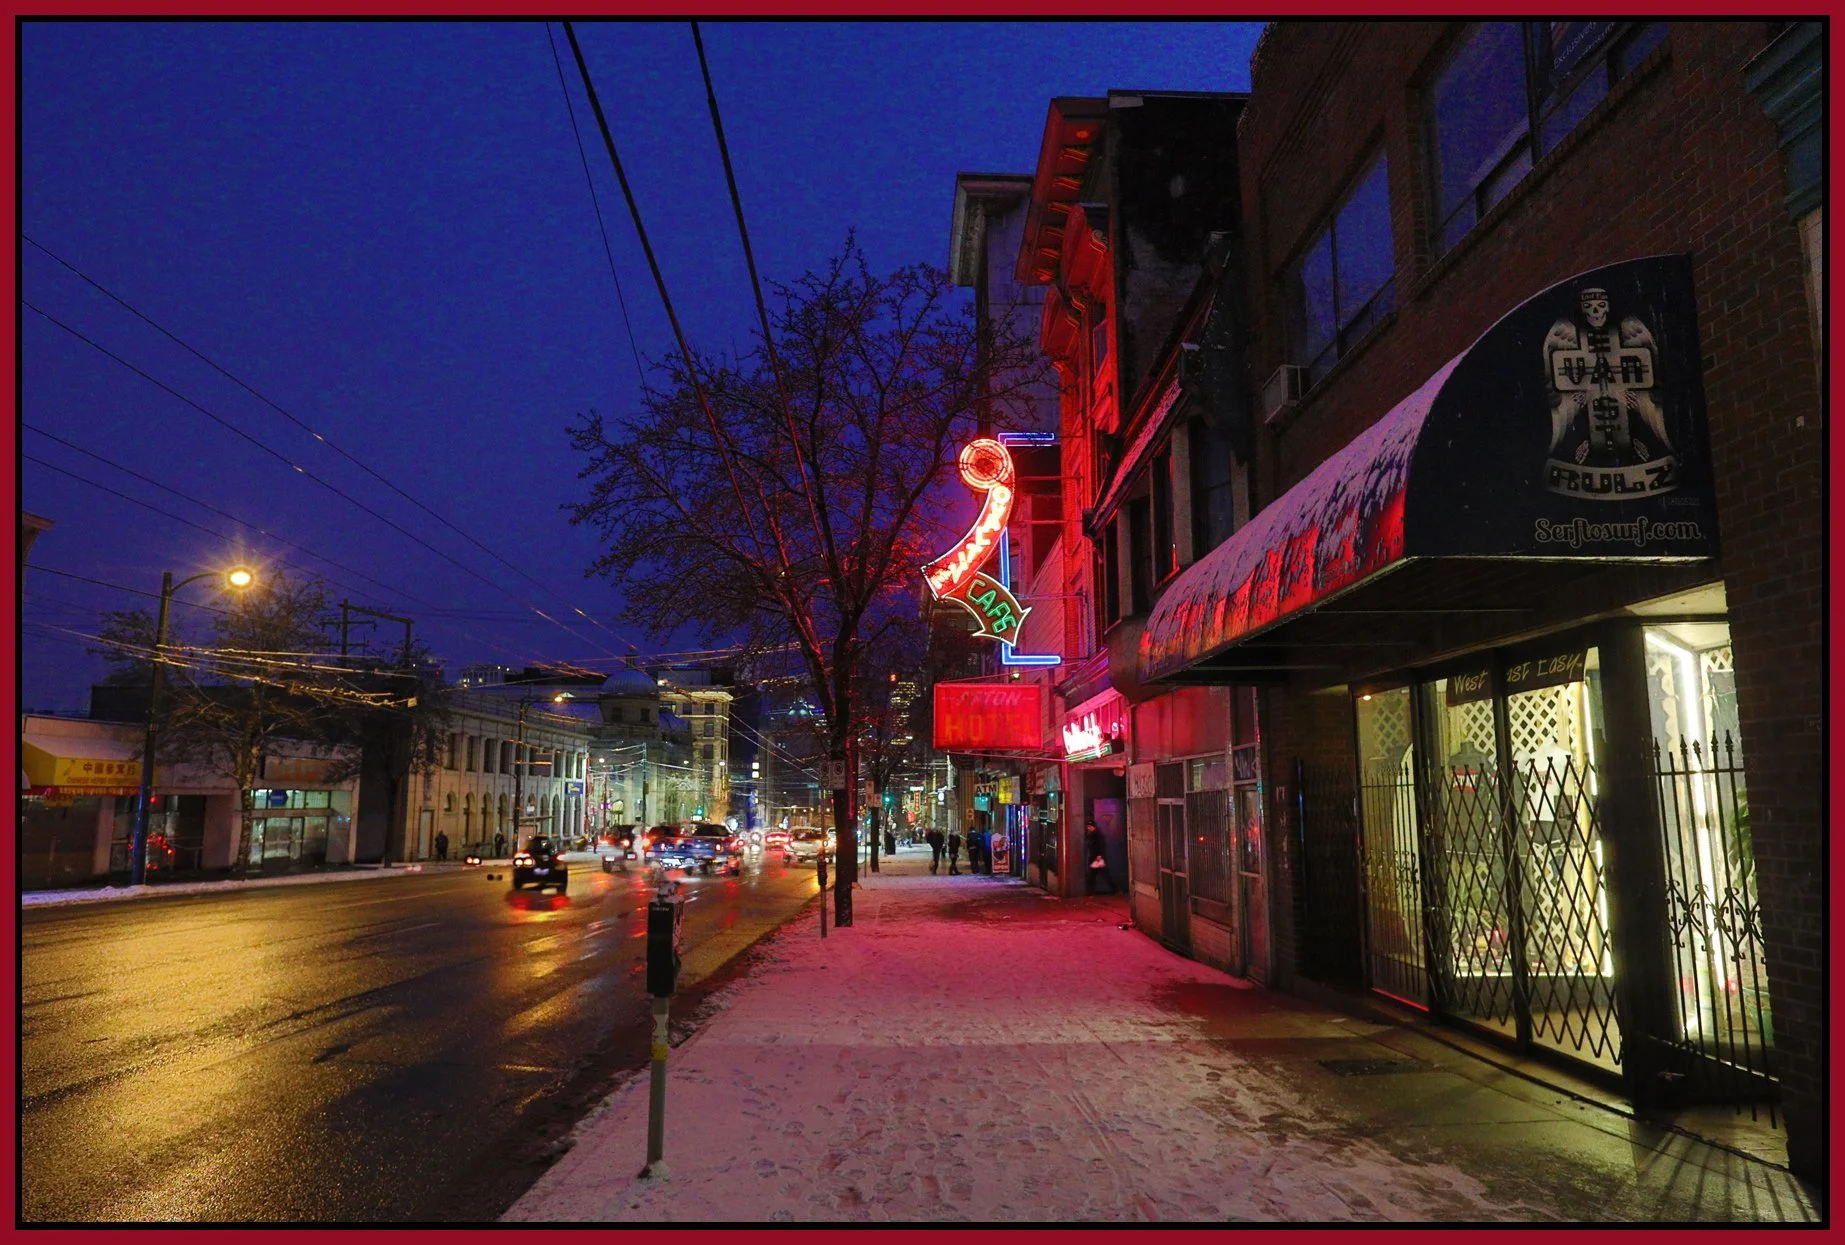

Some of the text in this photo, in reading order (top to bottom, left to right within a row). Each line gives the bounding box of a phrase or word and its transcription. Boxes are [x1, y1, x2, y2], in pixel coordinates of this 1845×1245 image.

[1535, 515, 1702, 549] Serftosurf.com
[1454, 669, 1489, 695] West
[944, 713, 1038, 742] HOTEL
[975, 784, 997, 794] ATM
